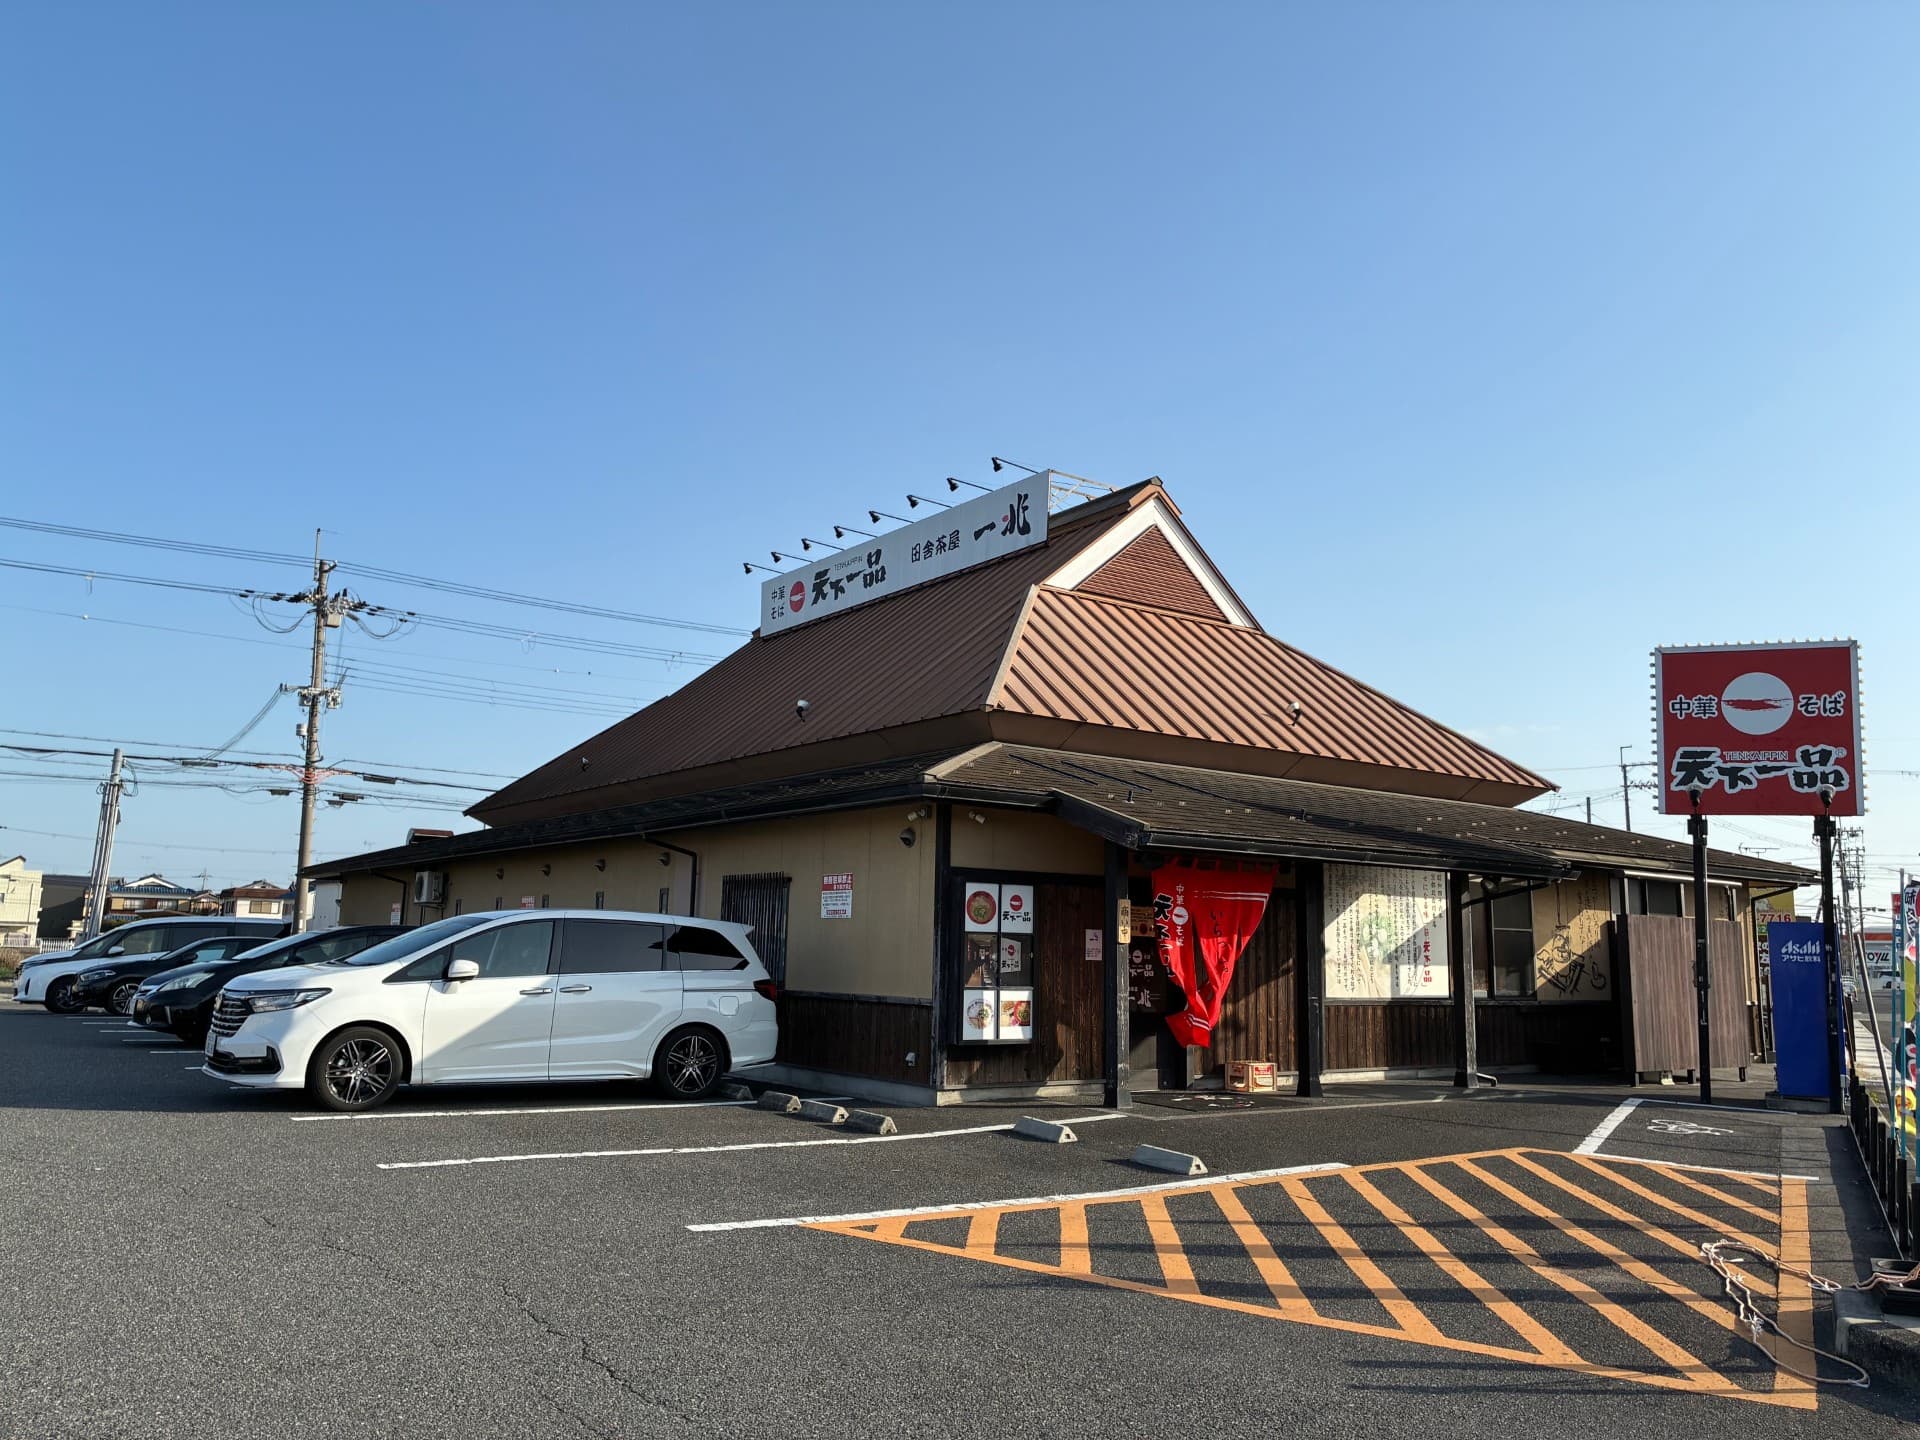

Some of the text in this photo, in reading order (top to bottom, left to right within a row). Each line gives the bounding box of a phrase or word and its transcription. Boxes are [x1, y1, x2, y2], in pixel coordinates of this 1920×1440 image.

[911, 529, 960, 563] 田舎茶屋
[811, 548, 886, 606] 天下一品
[771, 585, 785, 603] 中華
[770, 603, 785, 620] そば
[1670, 691, 1845, 718] 中華 そば
[1723, 751, 1788, 761] TENKAIPPIN
[1671, 745, 1848, 793] 天下一品
[1781, 940, 1820, 954] Asahi
